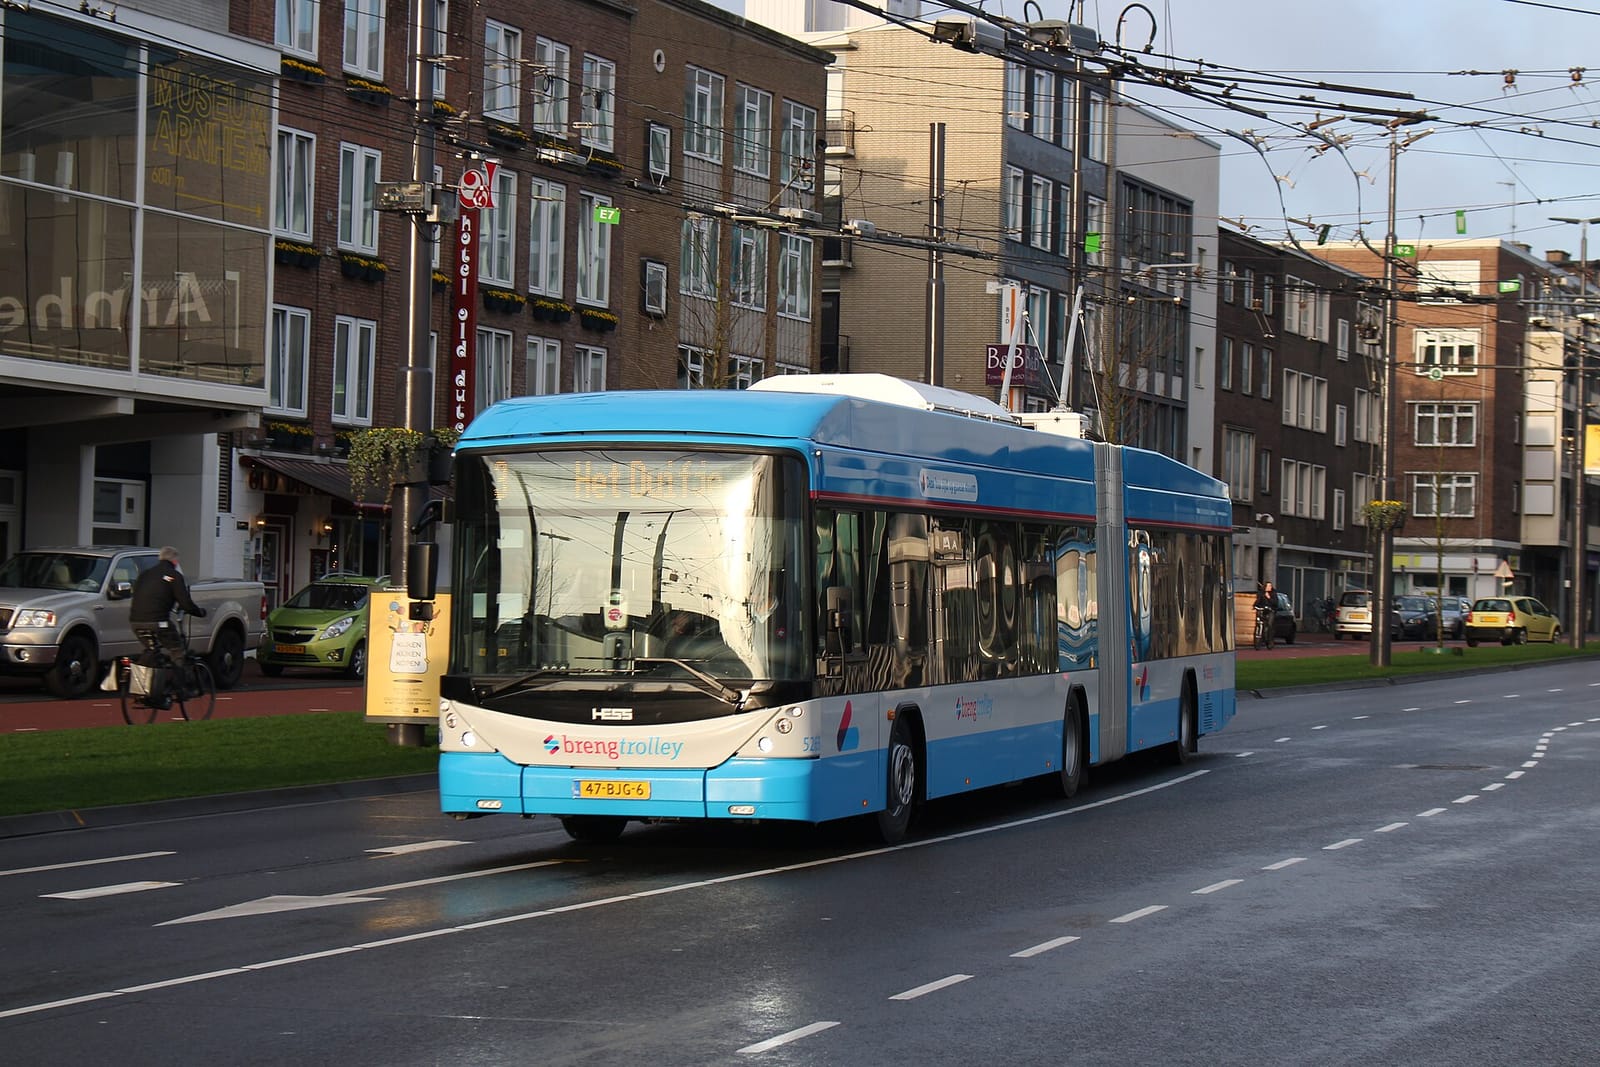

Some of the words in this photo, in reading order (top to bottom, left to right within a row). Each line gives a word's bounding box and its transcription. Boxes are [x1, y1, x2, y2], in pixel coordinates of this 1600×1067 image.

[154, 63, 268, 130] MUSEUM
[152, 110, 267, 176] ARNHEM
[152, 166, 171, 186] 600
[599, 209, 615, 220] E7
[460, 215, 472, 295] hotel
[455, 307, 469, 358] old
[988, 347, 1024, 369] B&B
[575, 460, 621, 498] Het
[591, 708, 633, 720] HESS
[561, 734, 684, 760] brengtrolley
[585, 783, 645, 796] 47-BJG-6
